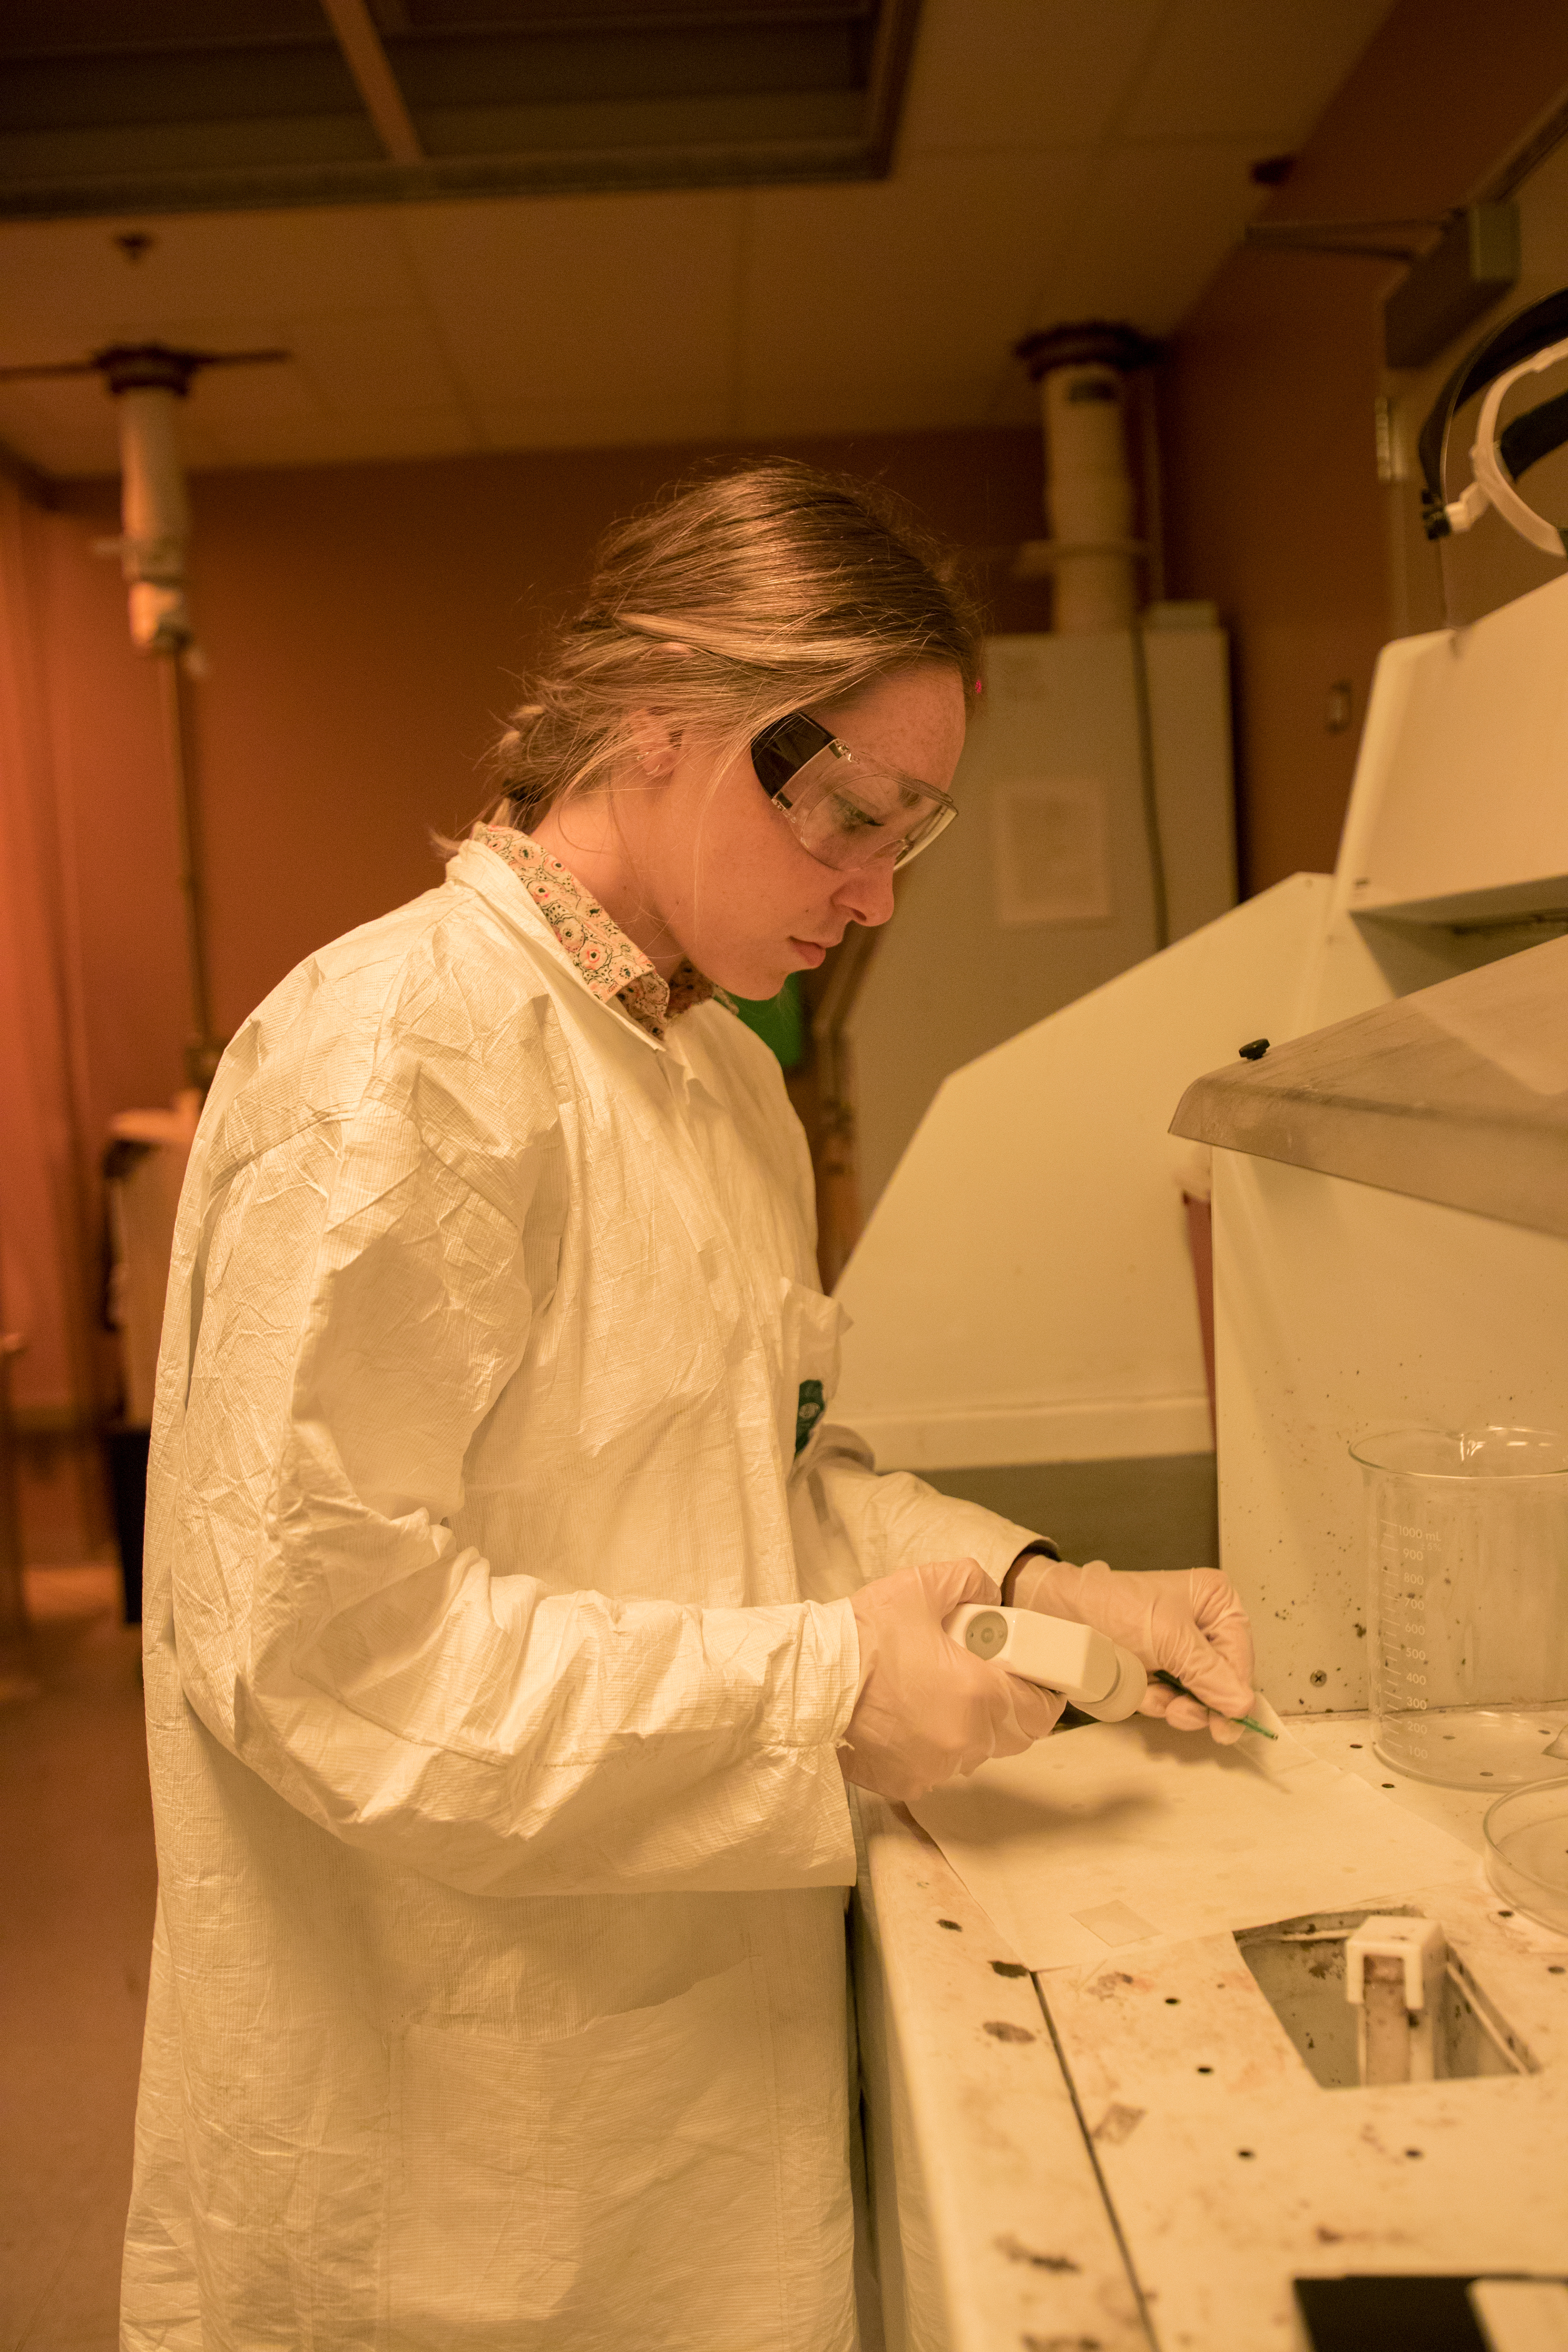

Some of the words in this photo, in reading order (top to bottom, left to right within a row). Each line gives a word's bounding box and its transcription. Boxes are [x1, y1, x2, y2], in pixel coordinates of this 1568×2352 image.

[1399, 1525, 1423, 1539] 1000
[1425, 1531, 1442, 1541] mL
[1403, 1548, 1423, 1561] 900
[1404, 1572, 1424, 1585] 800
[1405, 1597, 1424, 1610] 700
[1405, 1623, 1425, 1635] 600
[1405, 1647, 1425, 1660] 500
[1406, 1672, 1426, 1685] 400
[1407, 1696, 1427, 1710] 300
[1408, 1720, 1428, 1734] 200
[1409, 1745, 1428, 1759] 100
